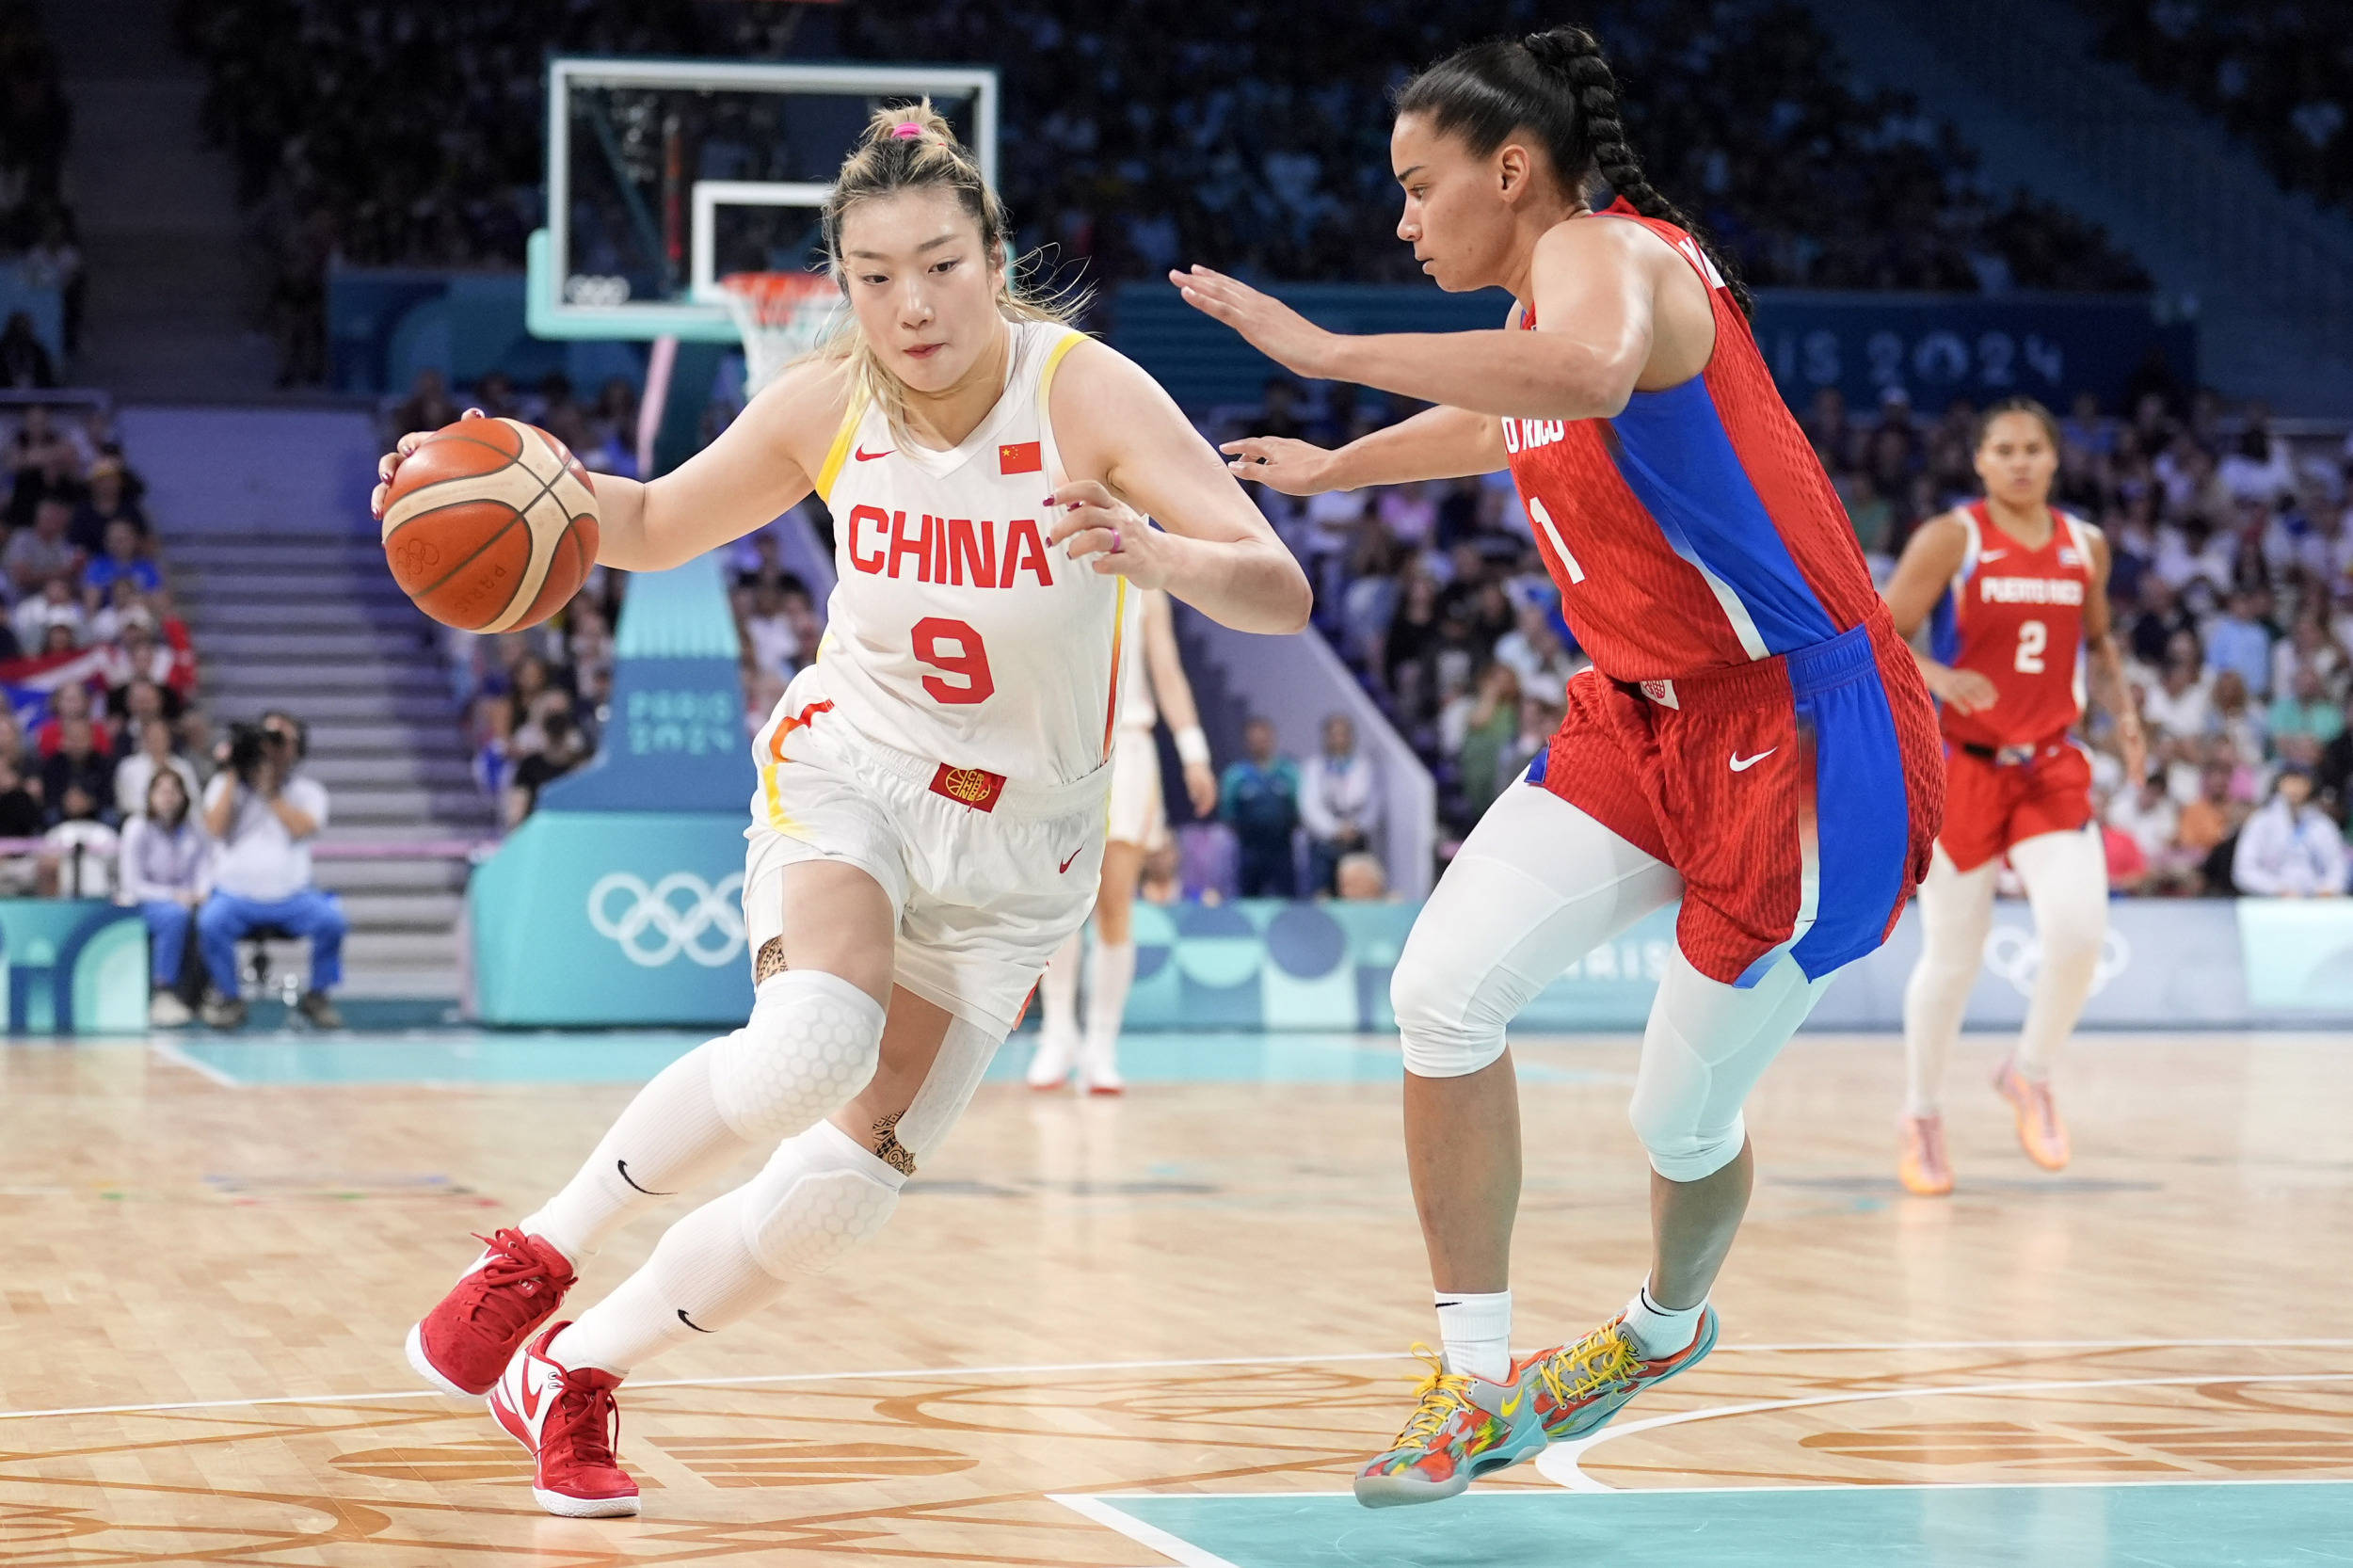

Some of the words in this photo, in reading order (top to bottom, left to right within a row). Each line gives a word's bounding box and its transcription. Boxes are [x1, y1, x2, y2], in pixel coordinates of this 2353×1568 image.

[1868, 330, 2063, 386] 2024
[849, 504, 1053, 588] CHINA
[1529, 496, 1586, 584] 1
[455, 565, 507, 614] PARIS
[1980, 577, 2045, 604] PUERTO
[911, 616, 995, 704] 9
[2014, 619, 2047, 674] 2
[628, 691, 732, 722] PARIS
[629, 723, 734, 756] 2024
[1559, 942, 1671, 981] RIS
